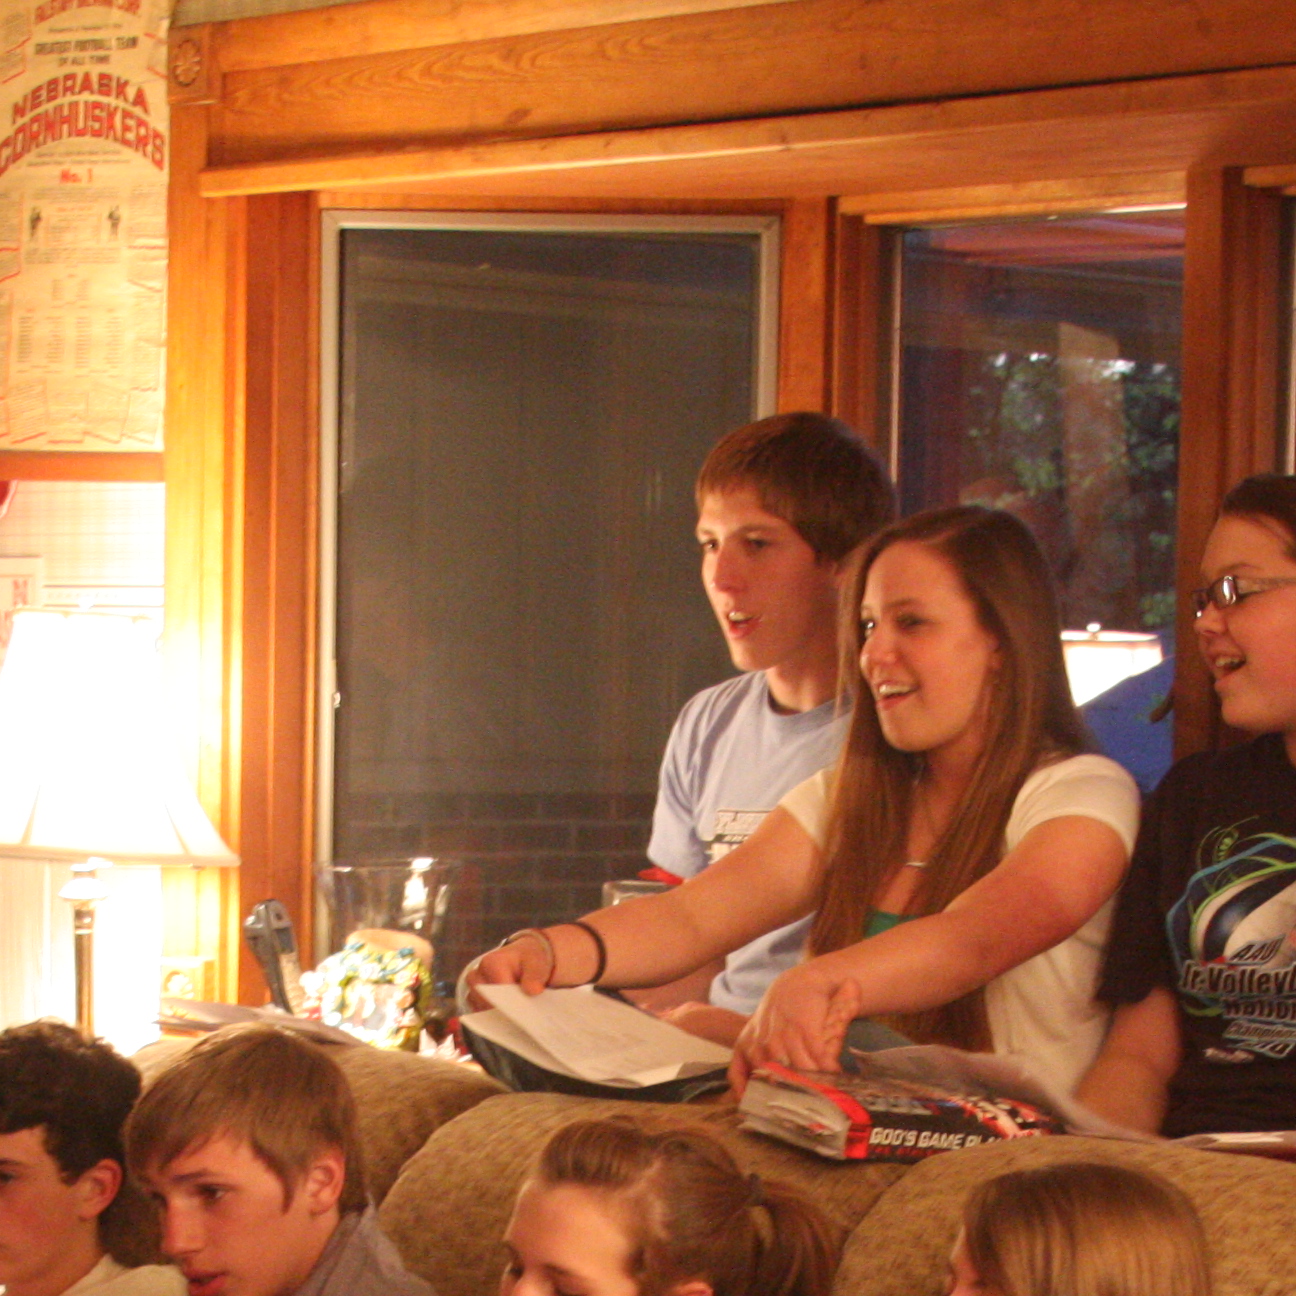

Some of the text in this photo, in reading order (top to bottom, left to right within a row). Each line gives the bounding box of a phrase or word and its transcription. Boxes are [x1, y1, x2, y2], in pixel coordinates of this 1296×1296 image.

[12, 71, 150, 124] NEBRASKA
[60, 168, 82, 183] No.
[1230, 935, 1285, 963] AAU
[869, 1127, 917, 1147] GOD'S
[917, 1131, 966, 1150] GAME
